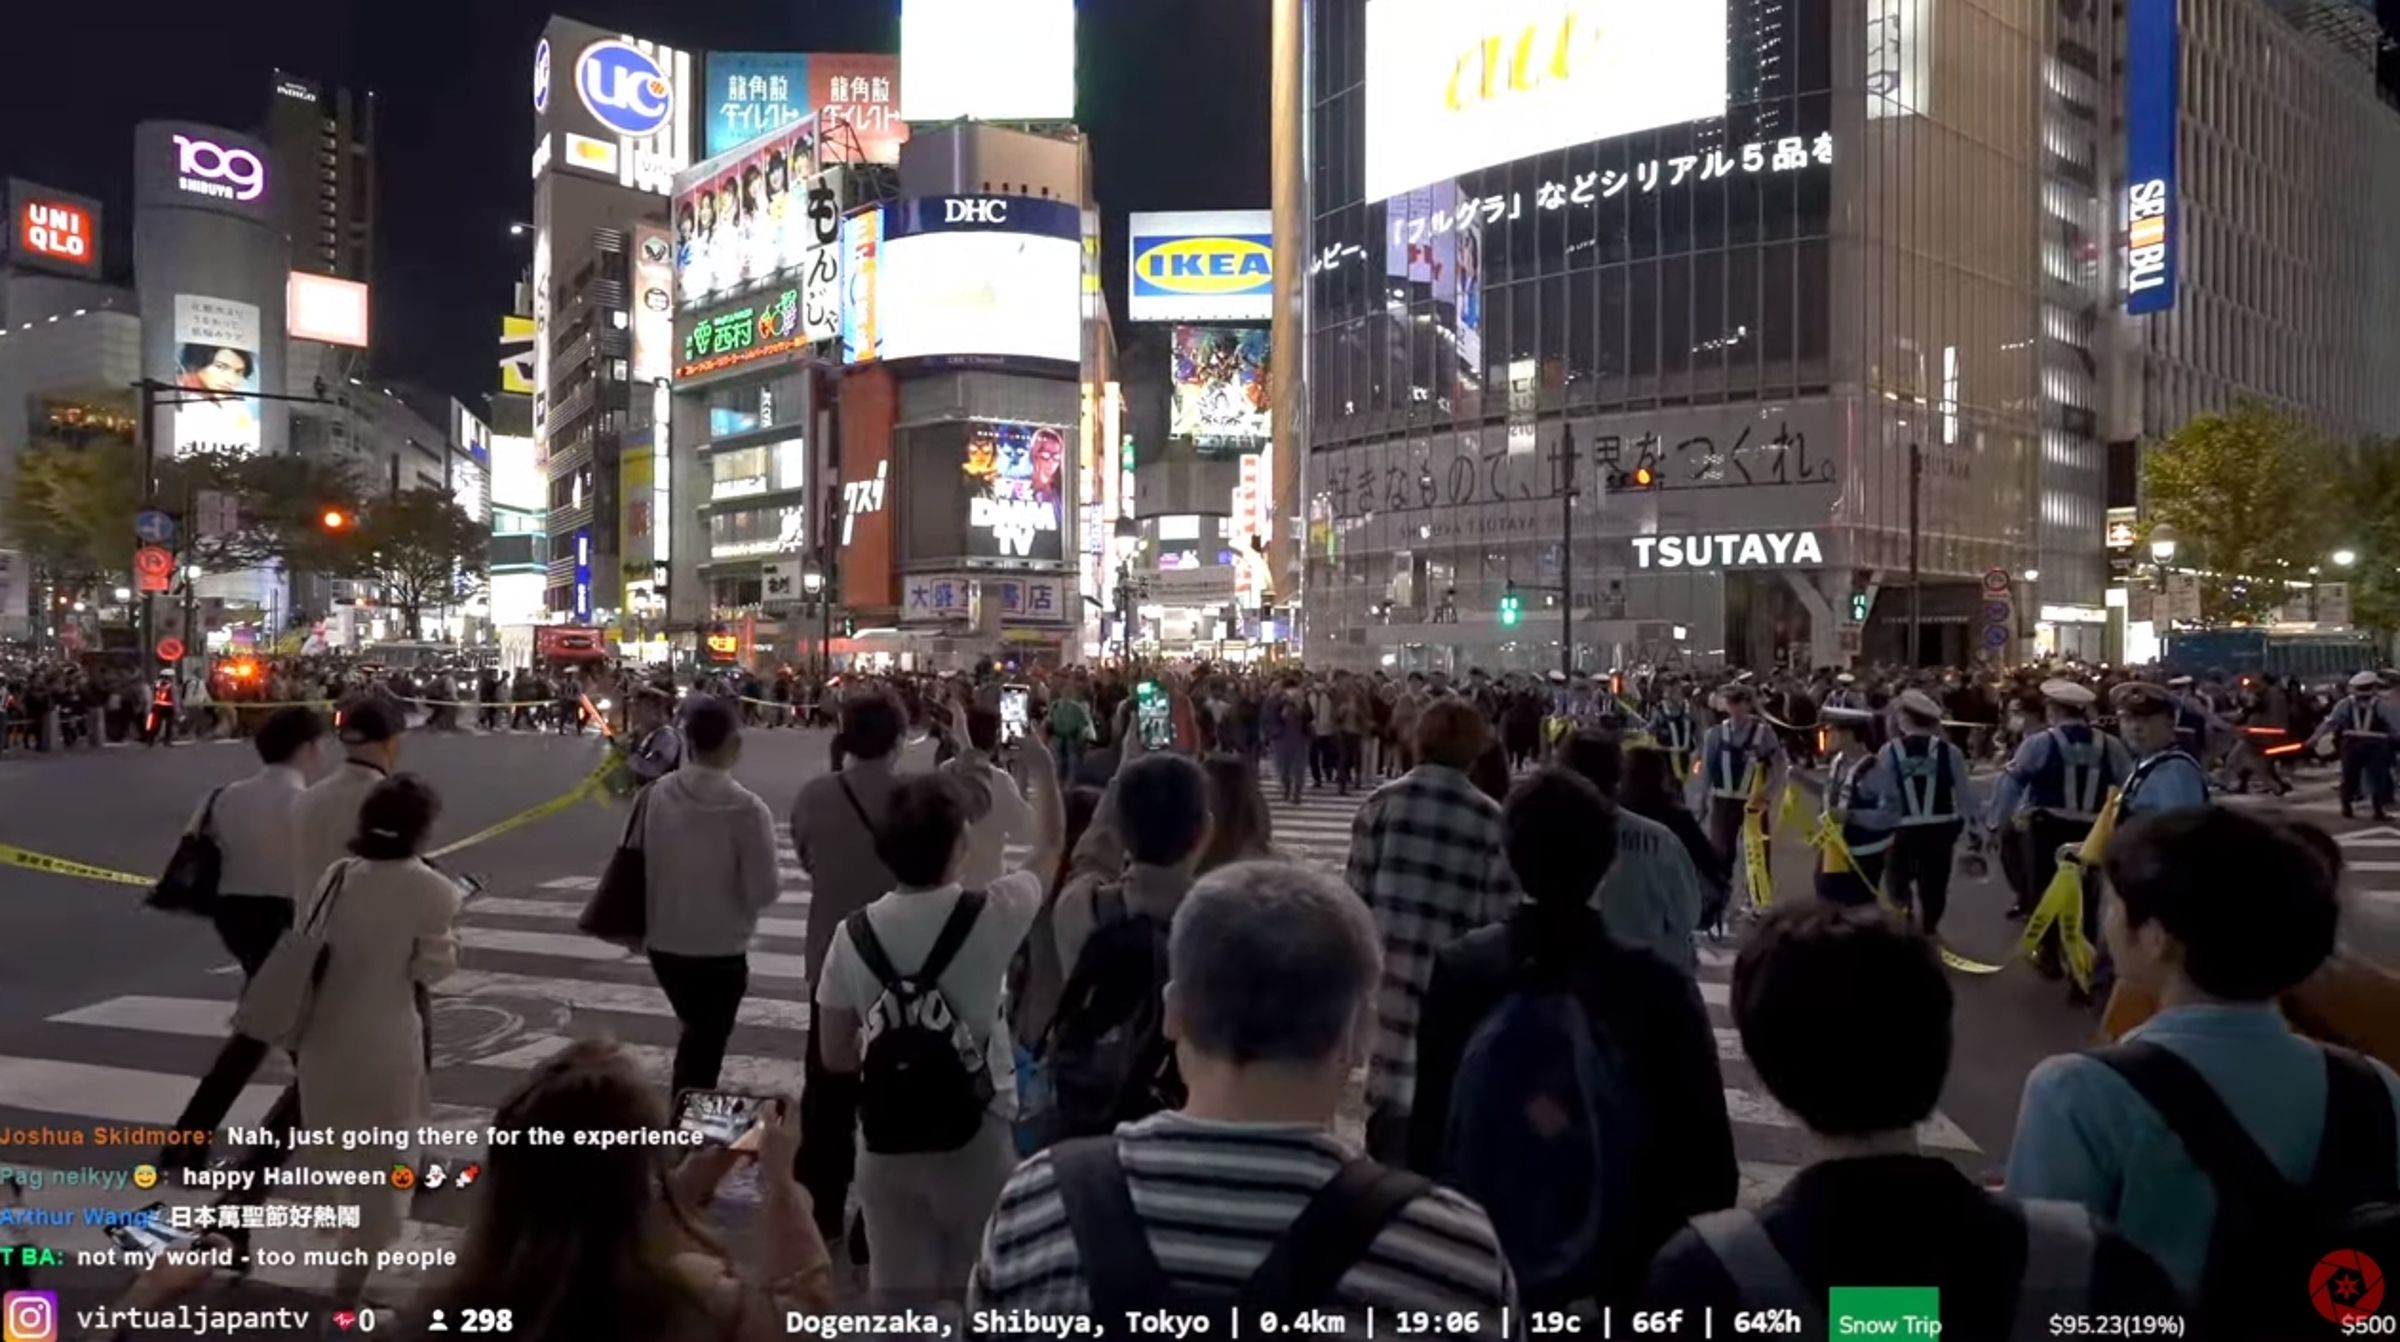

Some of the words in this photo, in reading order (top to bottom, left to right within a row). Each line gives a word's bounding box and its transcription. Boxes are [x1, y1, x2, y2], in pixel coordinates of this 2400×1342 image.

[587, 58, 666, 118] UC
[728, 74, 789, 102] 龍角散
[830, 75, 890, 103] 龍角散
[173, 135, 264, 200] 109
[179, 177, 234, 199] SHIBUYA
[29, 203, 79, 235] UNI
[945, 200, 1007, 224] DHC
[29, 226, 84, 256] QLO
[1149, 252, 1270, 277] IKEA
[1632, 532, 1823, 568] TSUTAYA
[911, 583, 1053, 610] 大盛書店
